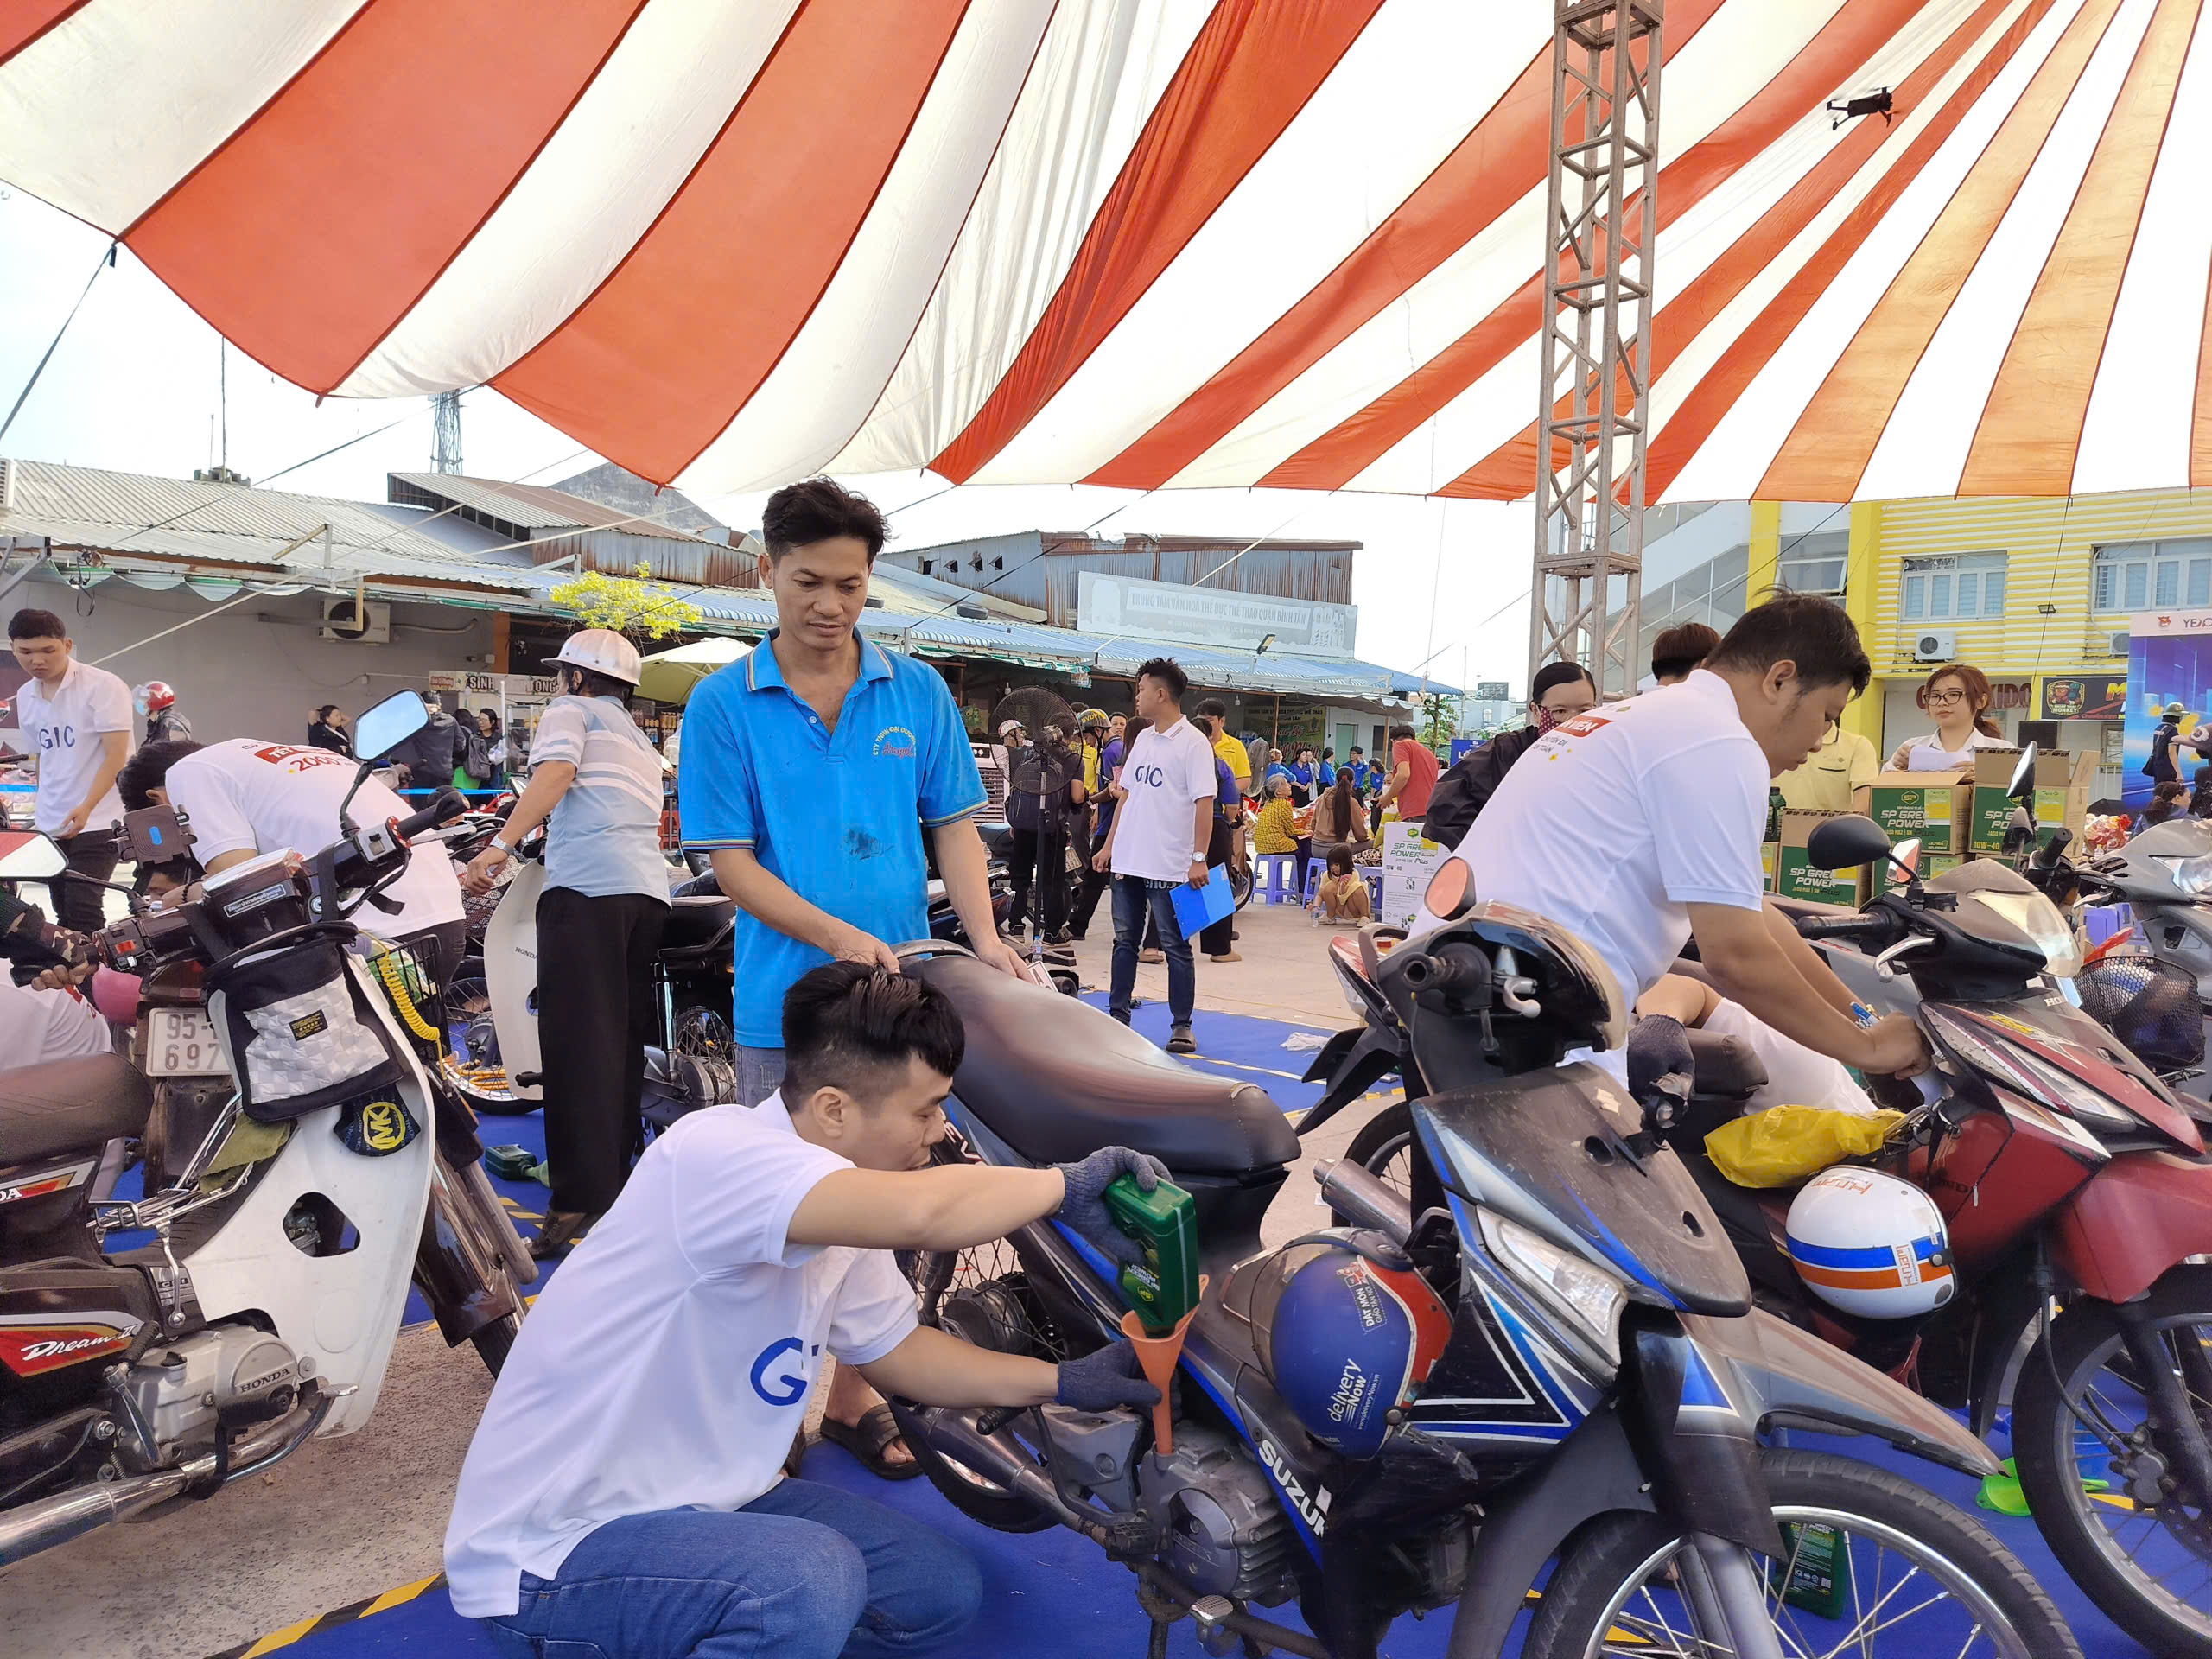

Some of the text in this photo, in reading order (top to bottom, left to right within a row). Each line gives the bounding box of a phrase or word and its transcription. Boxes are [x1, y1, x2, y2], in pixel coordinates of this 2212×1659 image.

[39, 725, 75, 749] GIC
[1135, 765, 1163, 787] GIC
[1887, 819, 1929, 828] POWER
[1898, 810, 1928, 819] GRE
[1984, 810, 2002, 820] SP
[1974, 841, 2000, 849] 10W-40
[1789, 868, 1833, 879] SP GRE
[1796, 877, 1836, 888] POWER
[2044, 996, 2063, 1007] HO
[167, 1014, 217, 1039] 95-
[369, 1107, 395, 1145] MK
[21, 1334, 115, 1361] Dream
[240, 1368, 291, 1394] HONDA
[750, 1336, 818, 1406] G
[1327, 1358, 1362, 1422] delivery
[1347, 1375, 1366, 1407] Now
[1259, 1440, 1325, 1538] SUZUK
